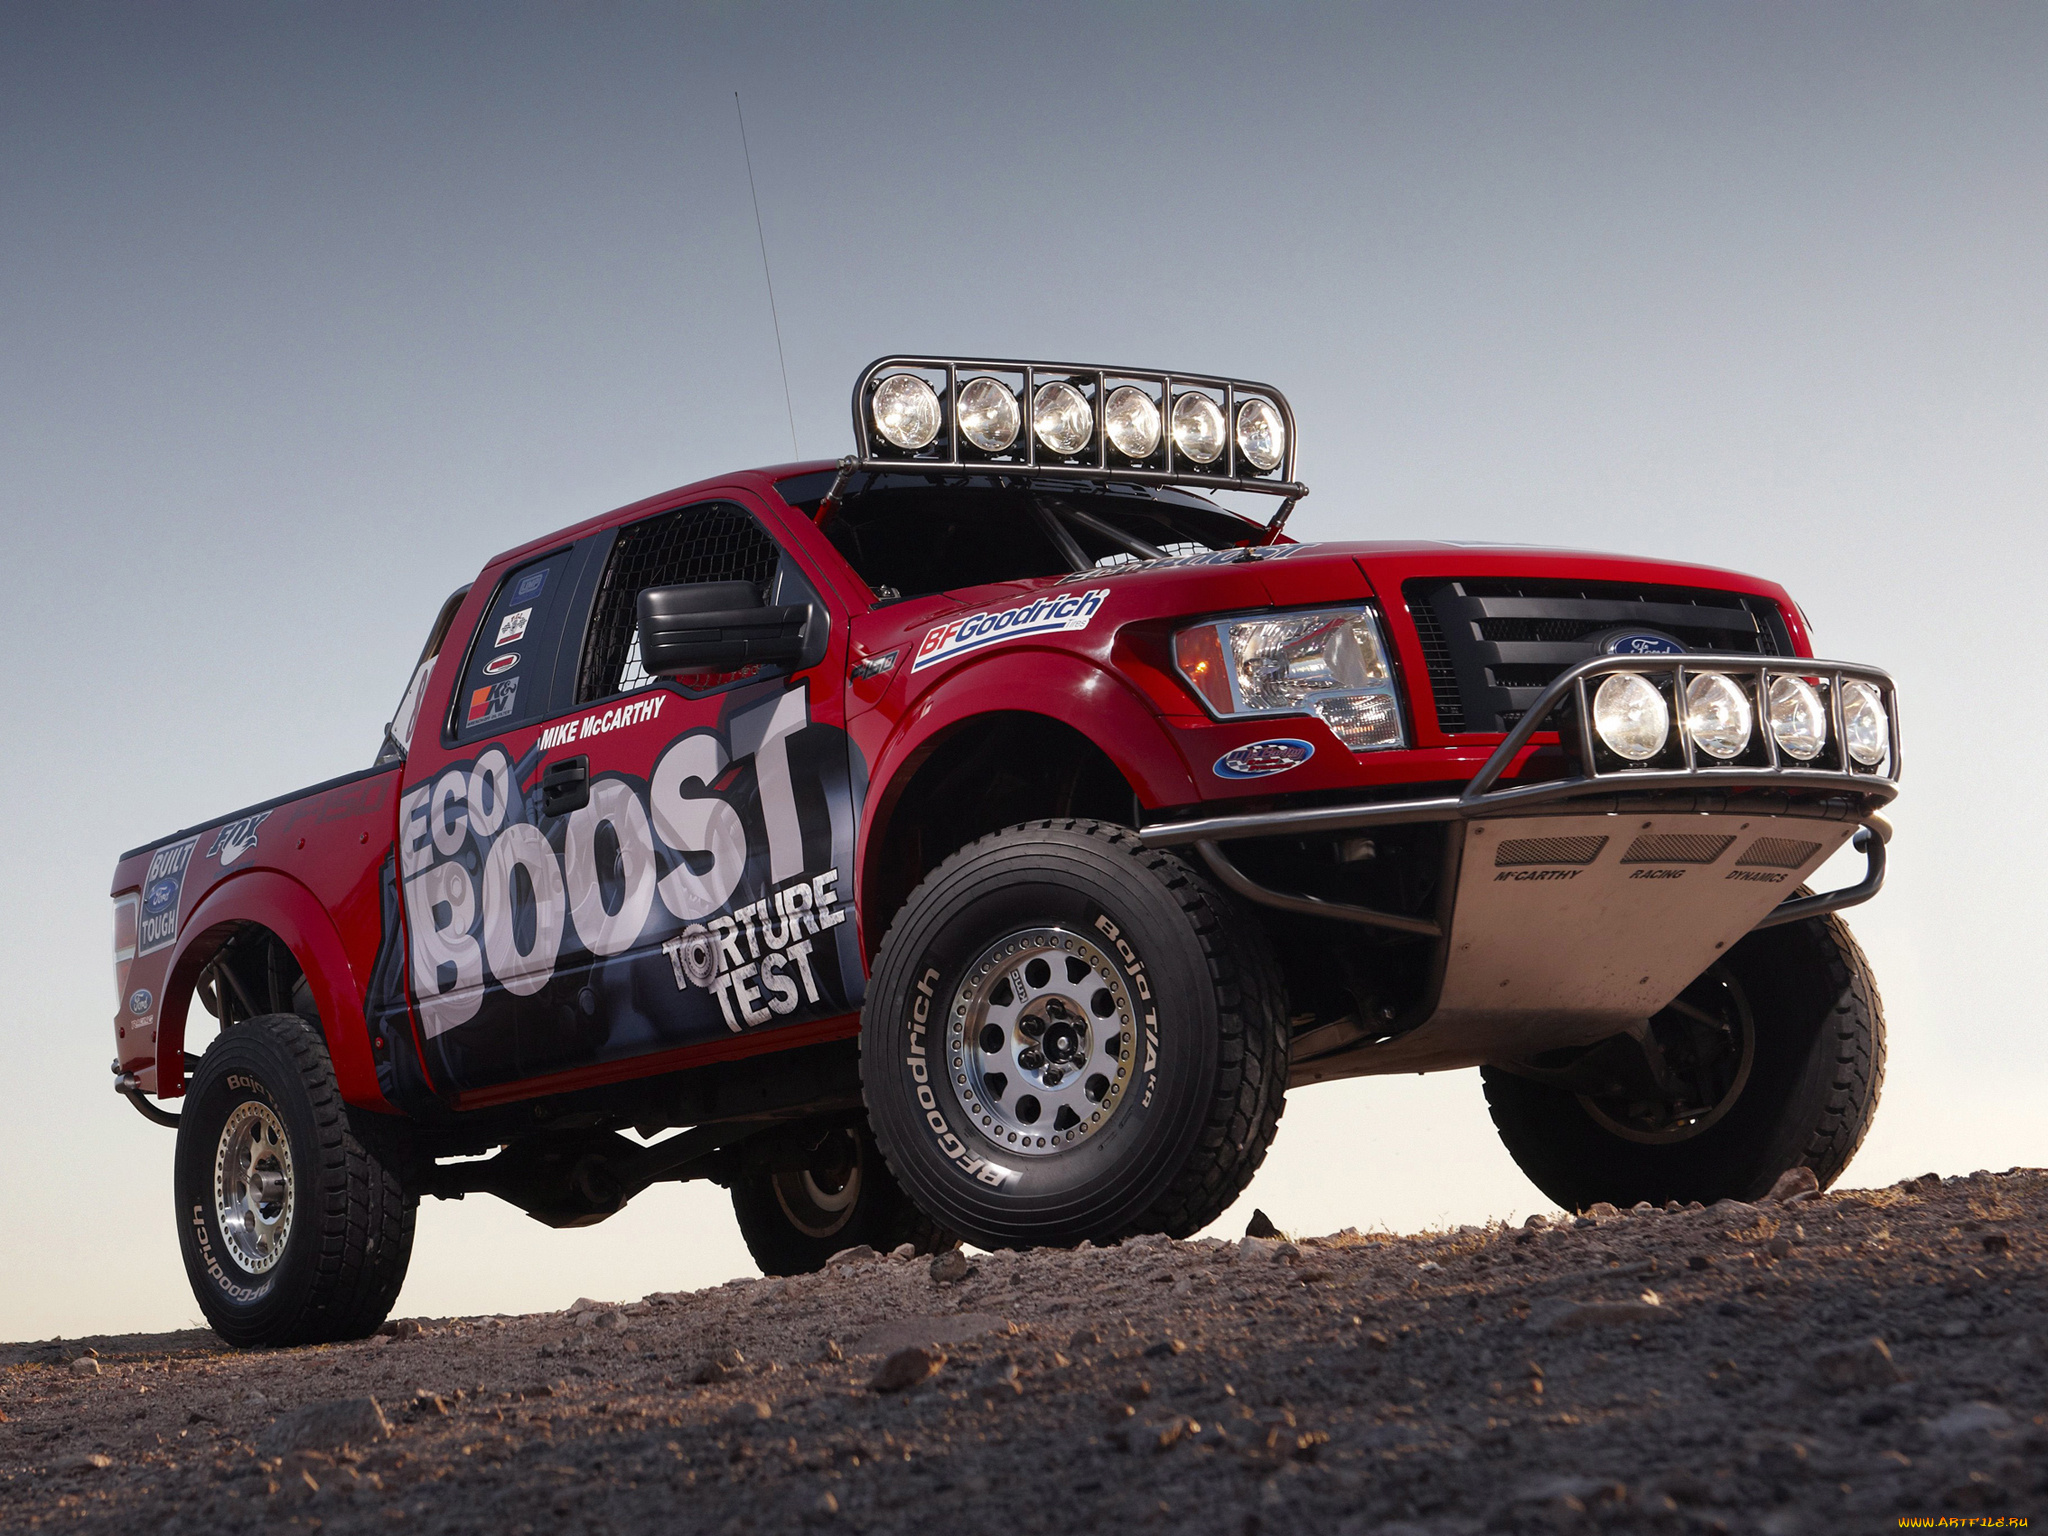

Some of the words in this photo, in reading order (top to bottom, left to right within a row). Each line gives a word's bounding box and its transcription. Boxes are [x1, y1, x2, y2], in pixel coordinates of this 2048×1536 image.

[918, 589, 1103, 657] BFGoodrich
[1065, 618, 1087, 628] Tires
[540, 720, 580, 750] MIKE
[579, 695, 667, 739] McCARTHY
[206, 810, 273, 858] FOX
[400, 749, 509, 878] ECO
[149, 842, 195, 881] BUILT
[405, 685, 808, 1041] BOOST
[1494, 870, 1583, 881] McCARTHY
[1629, 869, 1688, 880] RACING
[1725, 870, 1789, 883] DYNAMICS
[153, 886, 171, 906] Ford
[142, 910, 175, 944] TOUGH
[662, 868, 847, 990] TORTURE
[710, 942, 820, 1033] TEST
[1094, 914, 1151, 1000] Baja
[1144, 1007, 1159, 1073] T/A
[227, 1074, 267, 1094] Baja
[906, 967, 1012, 1188] BFGoodrich
[193, 1205, 273, 1302] BFGoodrich
